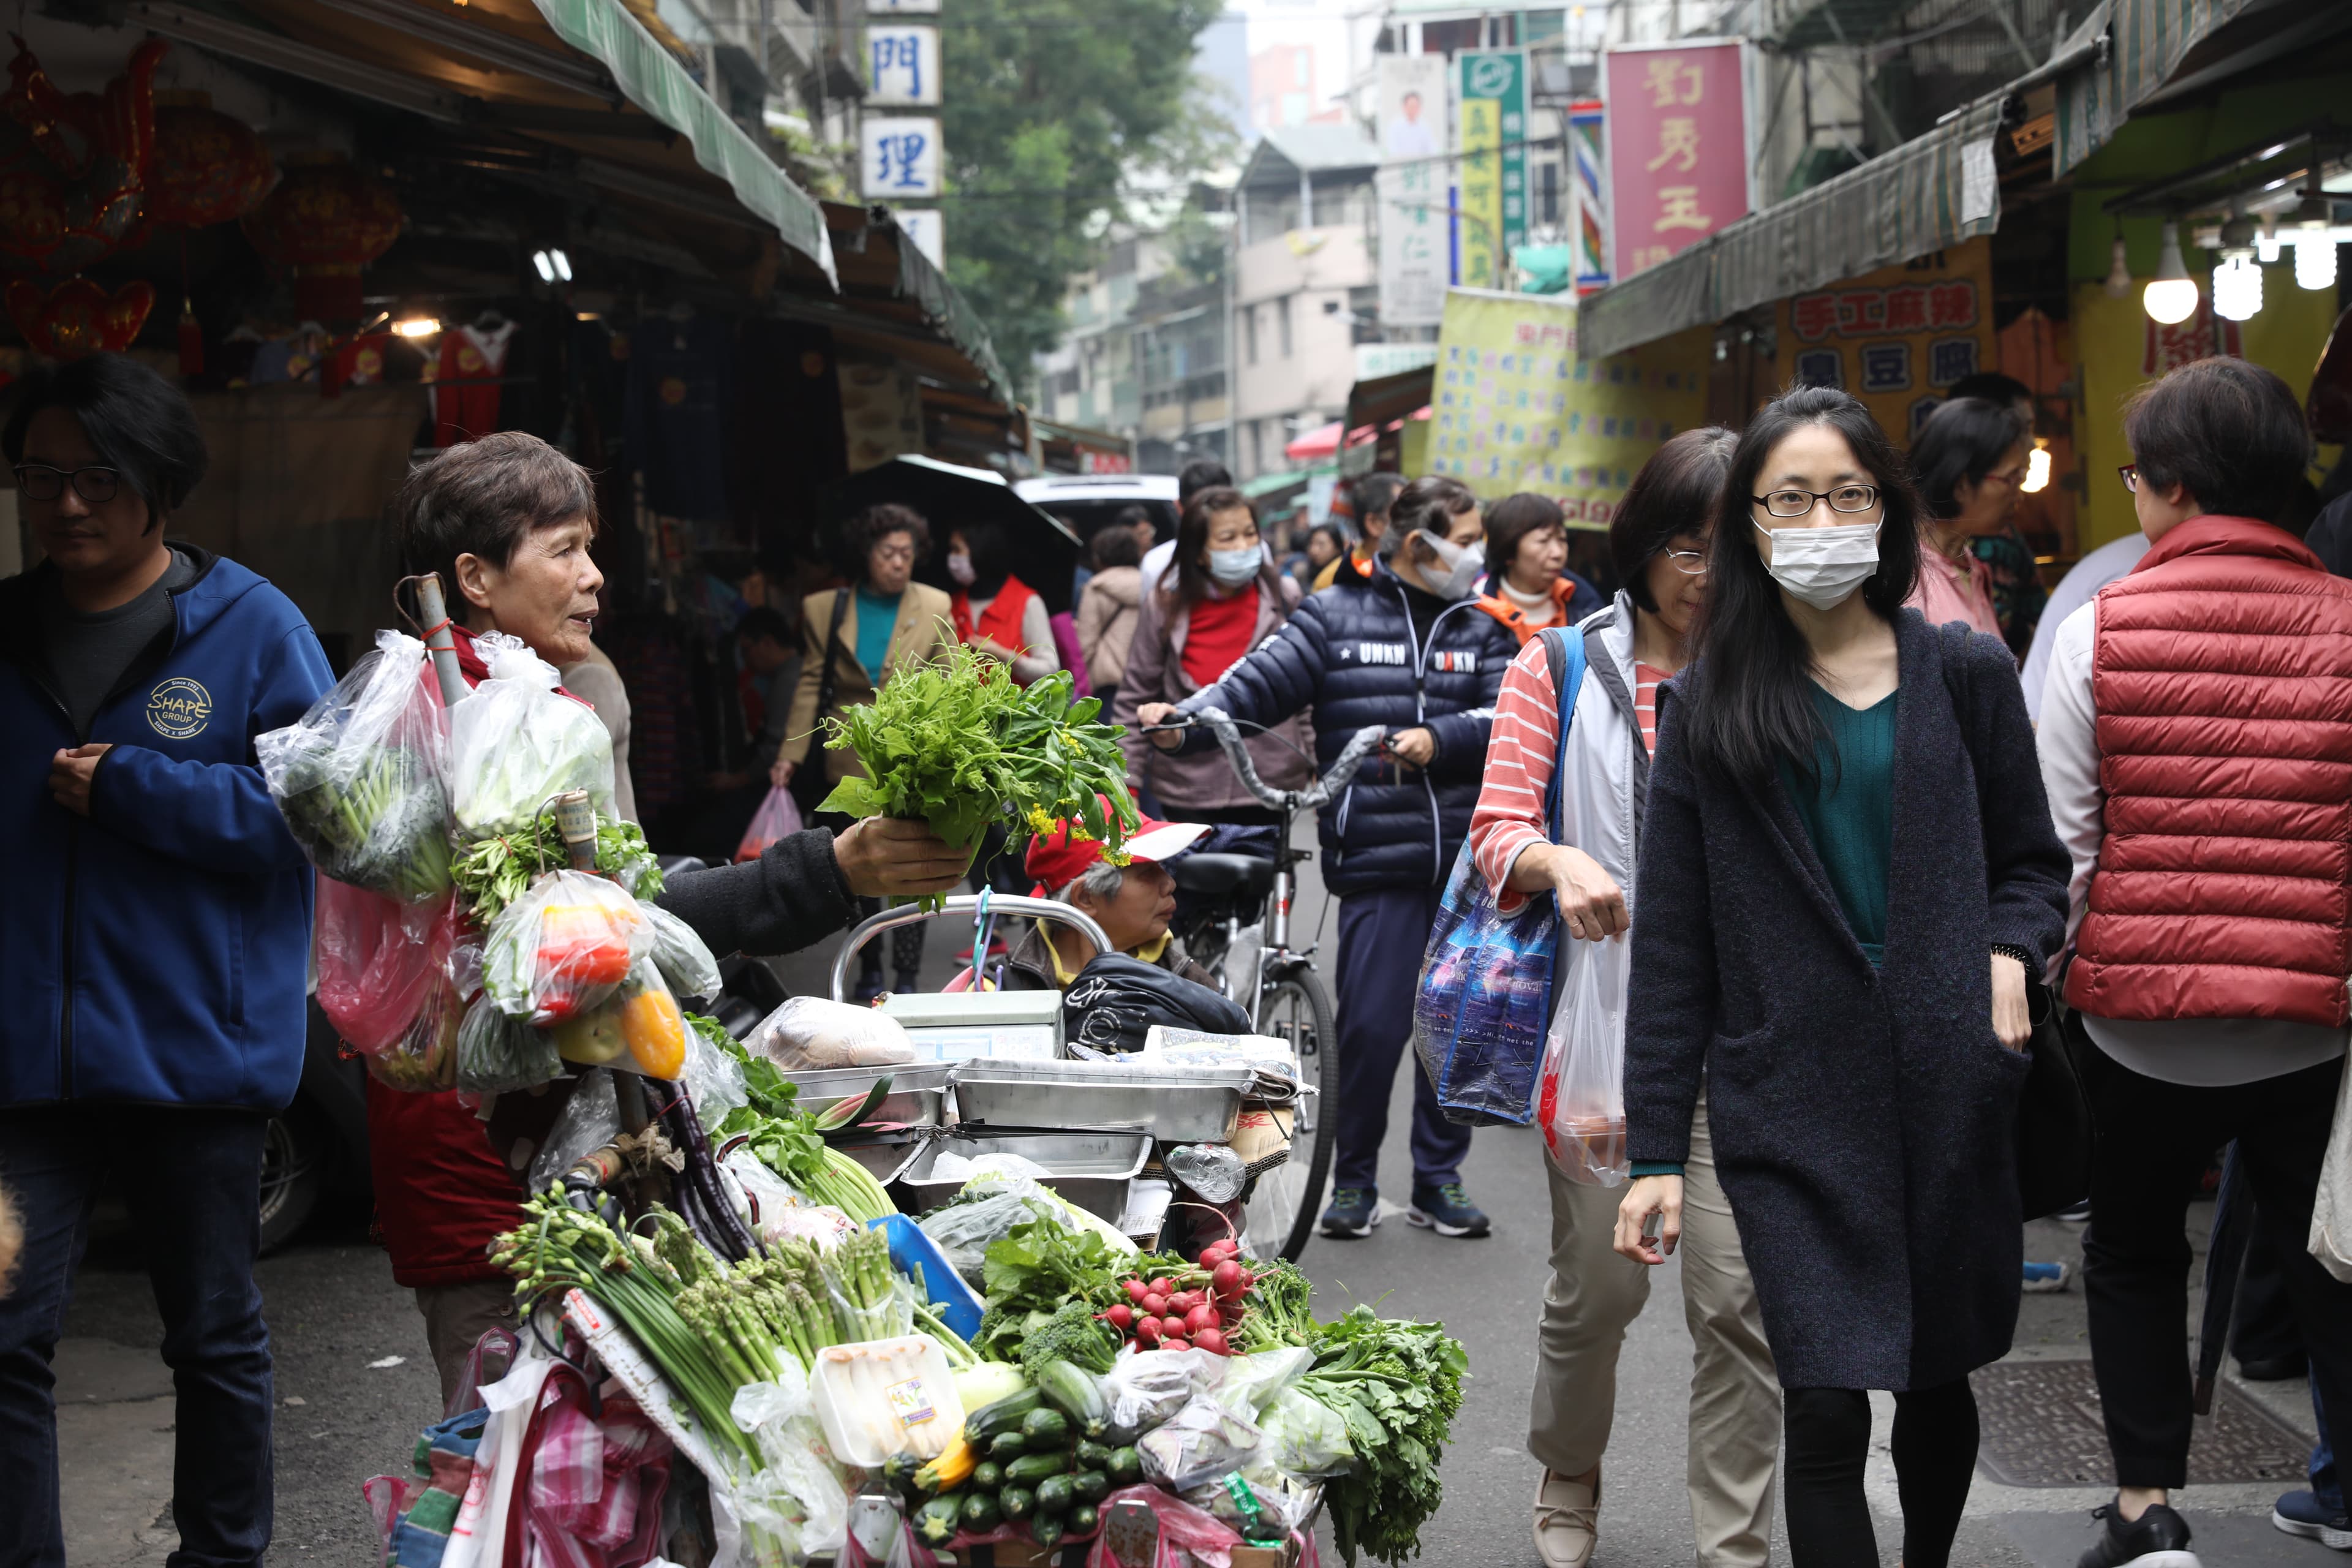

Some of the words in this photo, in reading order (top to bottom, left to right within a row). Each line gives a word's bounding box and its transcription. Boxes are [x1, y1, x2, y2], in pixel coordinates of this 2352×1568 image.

[1796, 283, 1973, 337] 手工麻辣
[1359, 643, 1406, 665] UNKN
[187, 682, 200, 692] 1992
[147, 693, 211, 718] SHAPE
[162, 711, 192, 723] GROUP
[154, 720, 170, 734] SHAPE
[178, 726, 197, 736] SHARE
